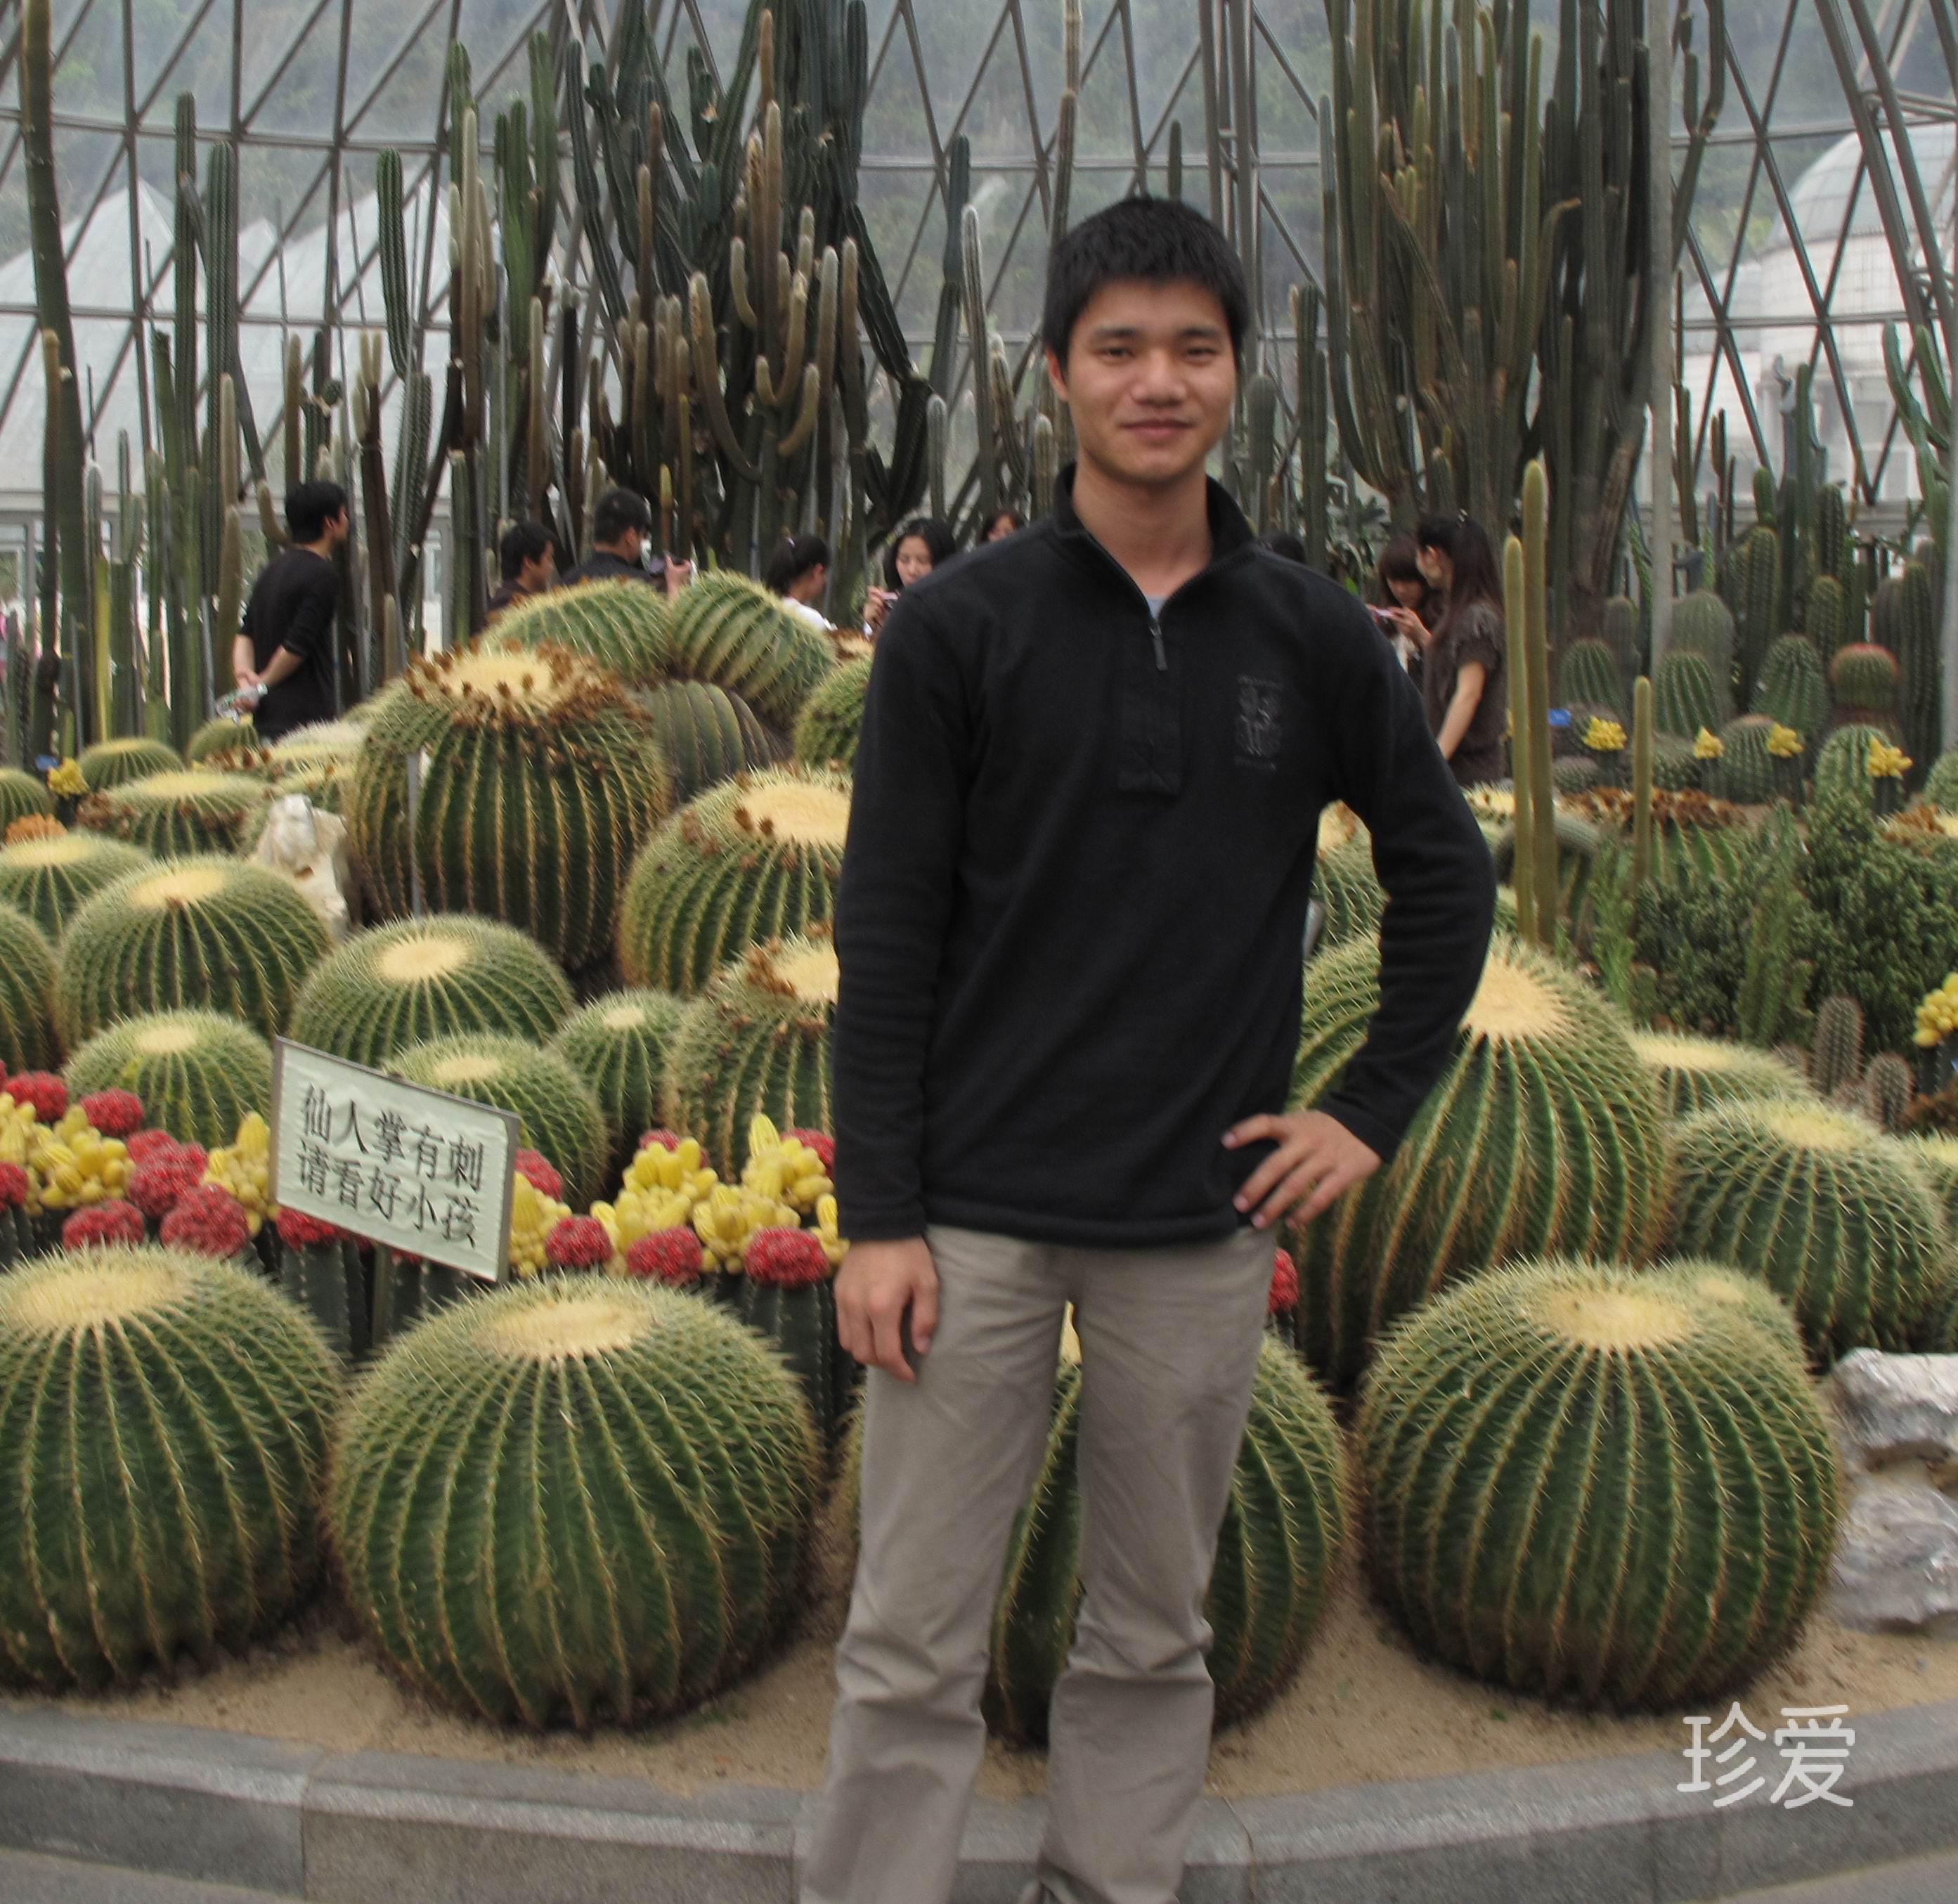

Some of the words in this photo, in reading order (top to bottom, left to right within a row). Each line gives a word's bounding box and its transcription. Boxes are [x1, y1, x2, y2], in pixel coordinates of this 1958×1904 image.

[302, 1083, 484, 1192] 仙人掌有刺
[297, 1138, 479, 1249] 请看好小孩
